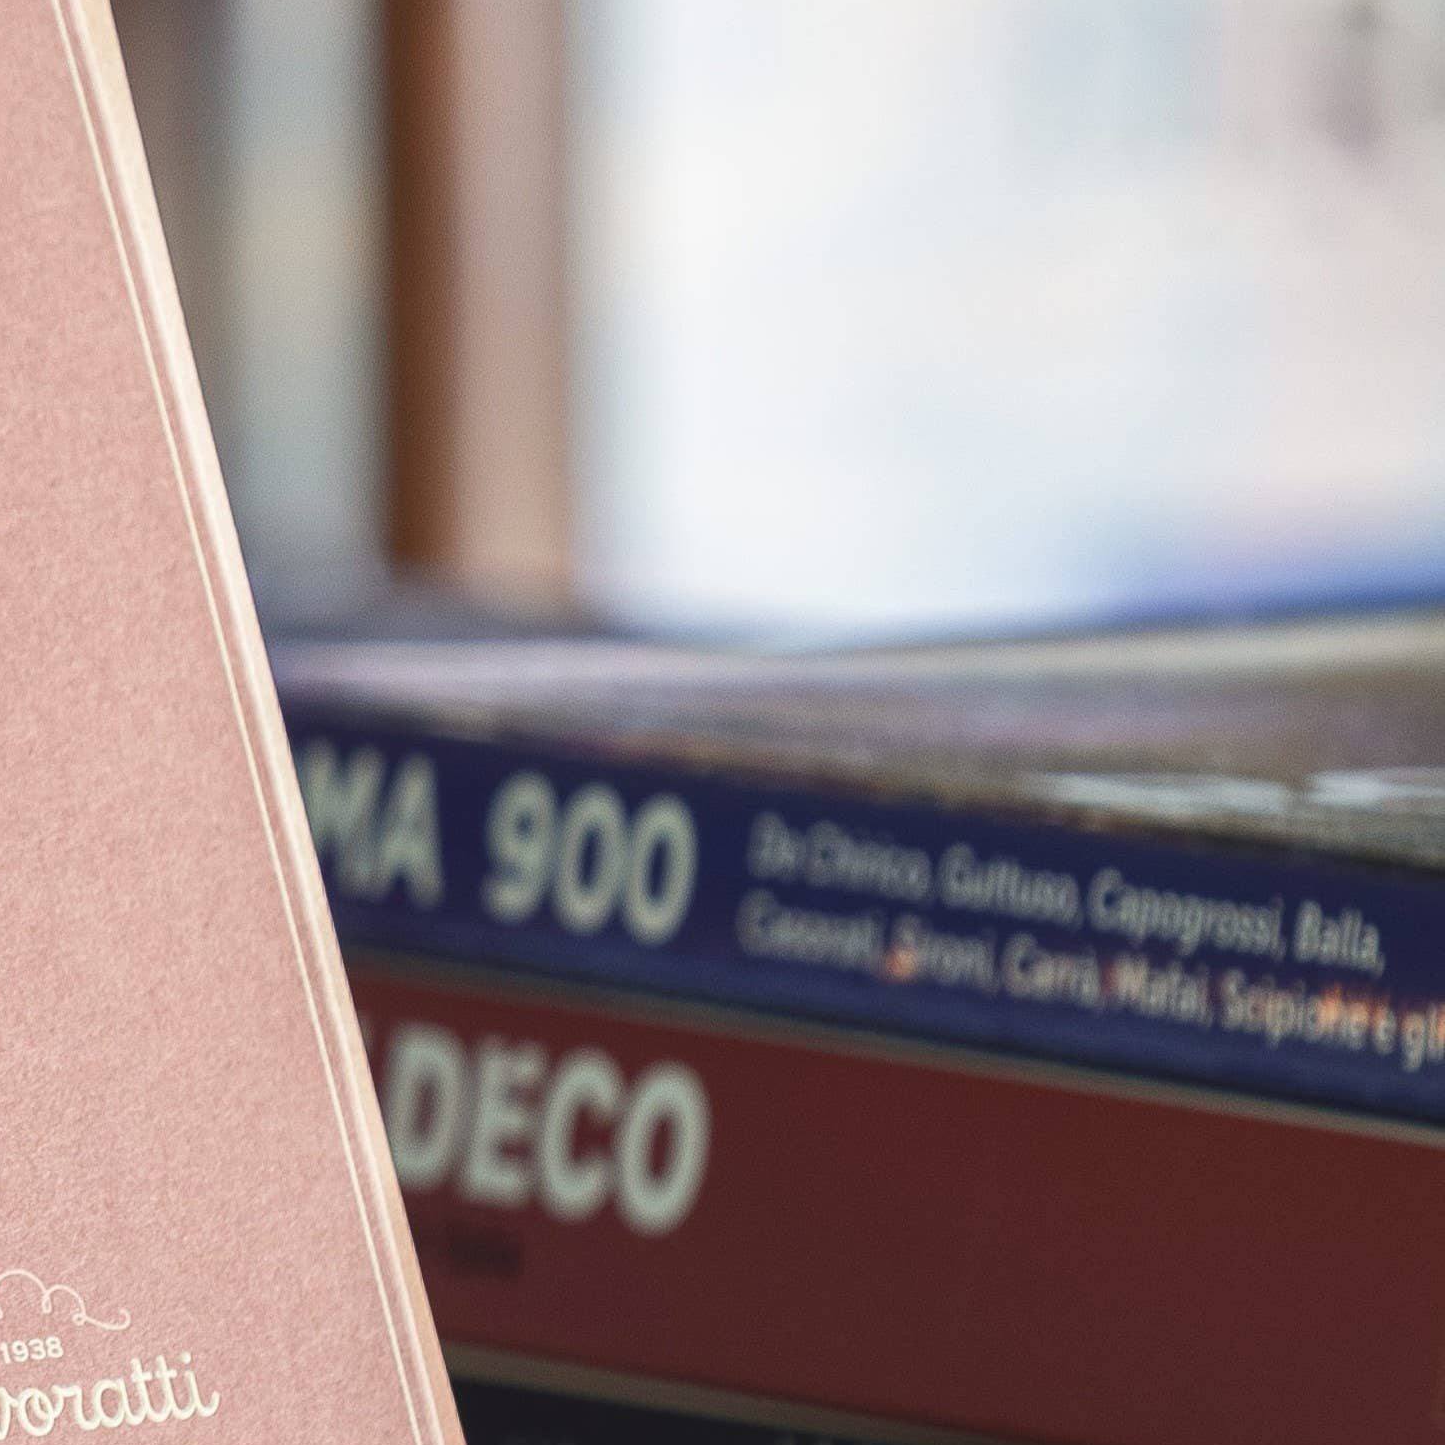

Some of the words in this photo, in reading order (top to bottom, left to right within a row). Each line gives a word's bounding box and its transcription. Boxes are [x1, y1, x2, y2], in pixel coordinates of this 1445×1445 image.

[481, 769, 698, 945] 900
[387, 1021, 710, 1237] DECO
[0, 1335, 64, 1364] 1938
